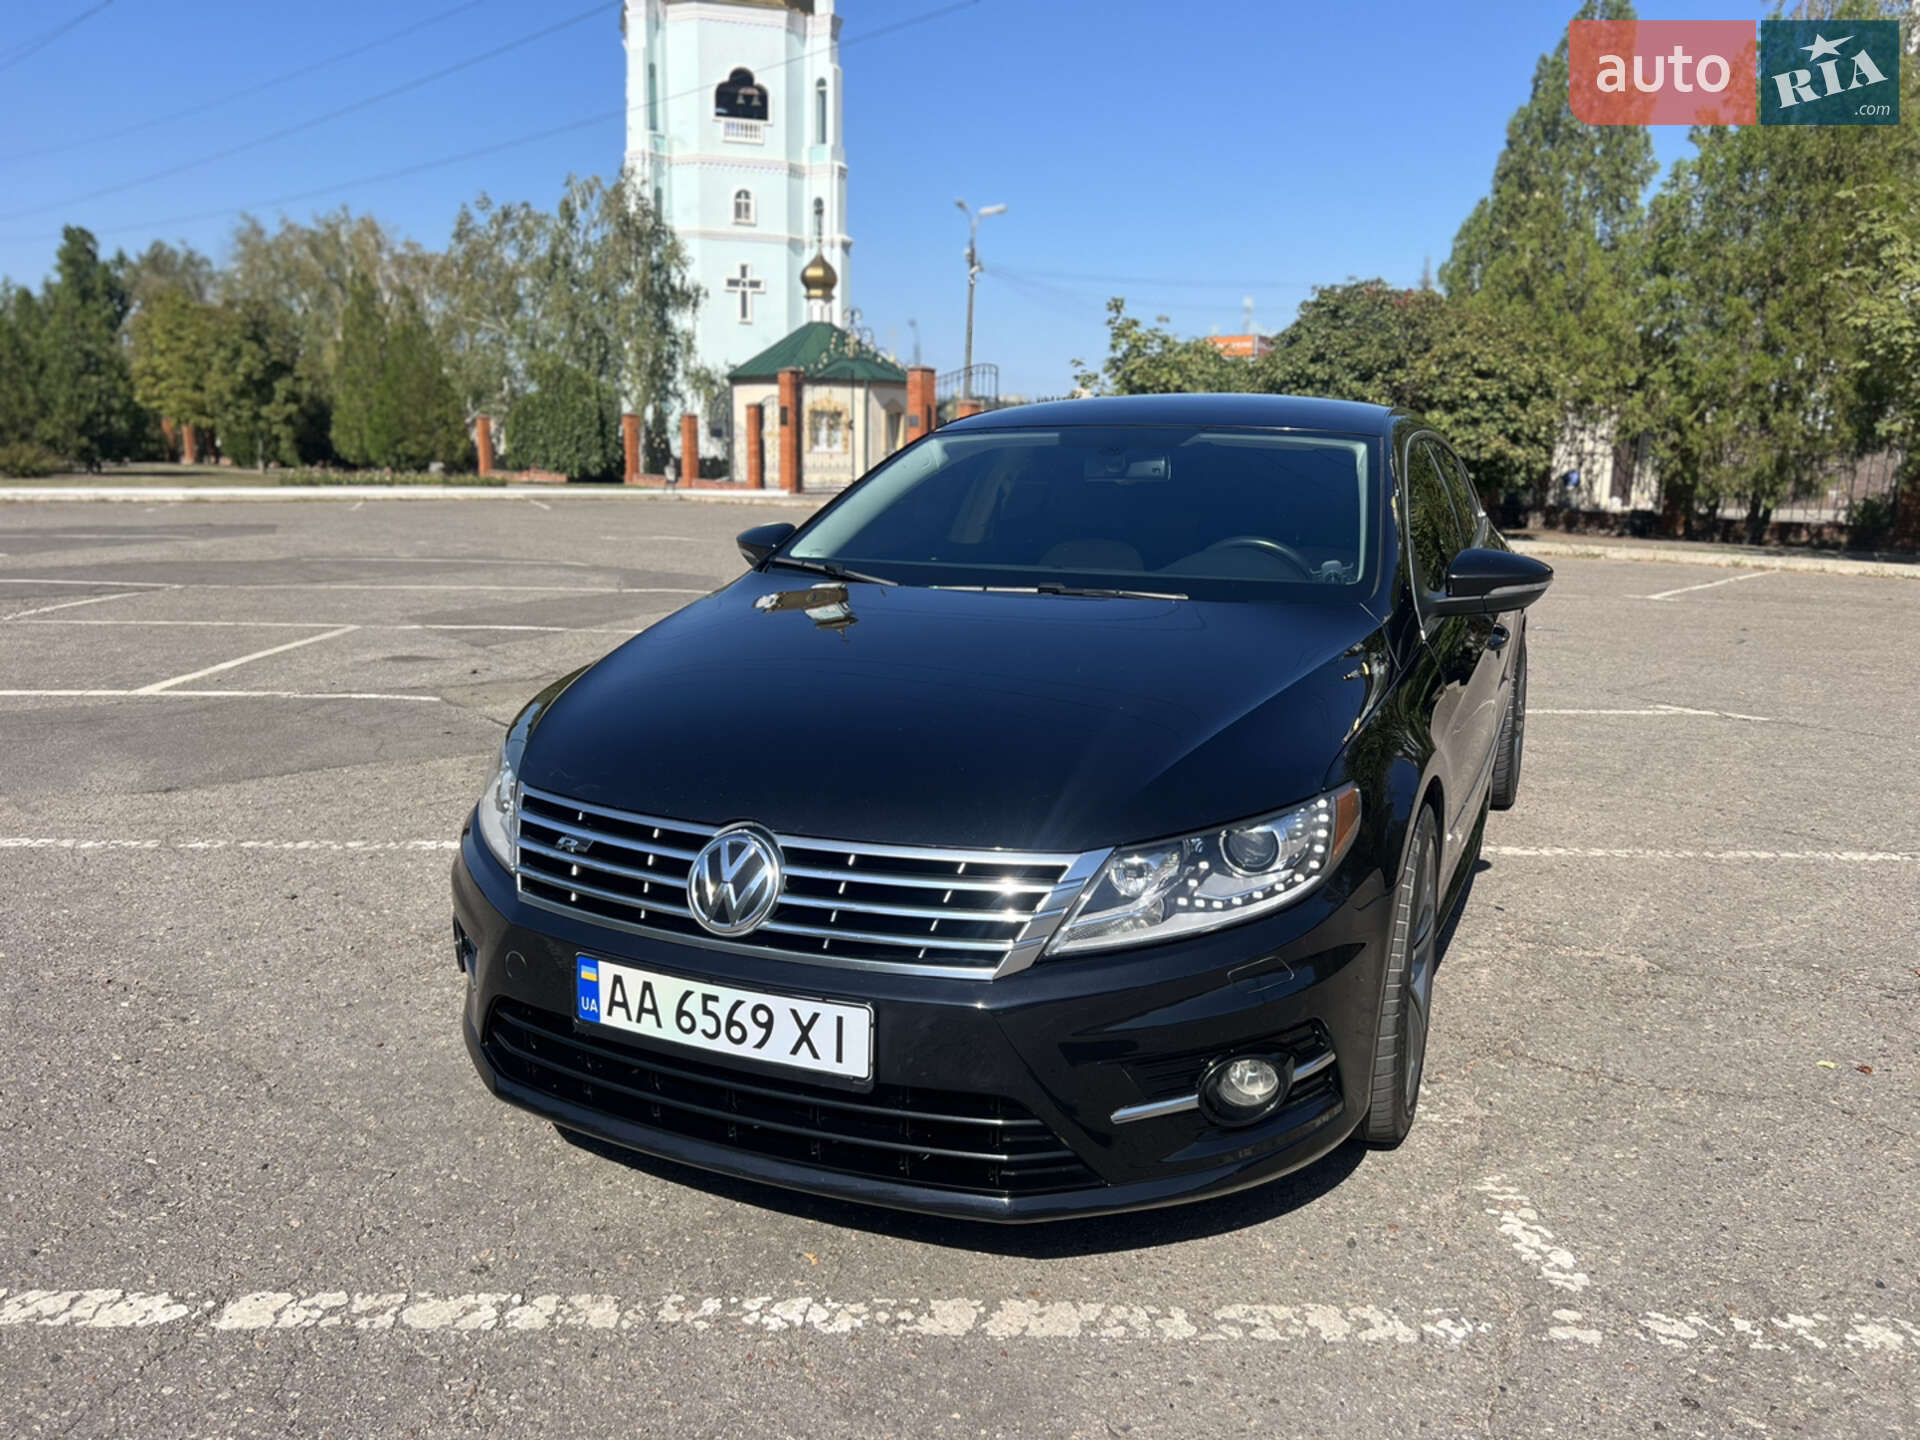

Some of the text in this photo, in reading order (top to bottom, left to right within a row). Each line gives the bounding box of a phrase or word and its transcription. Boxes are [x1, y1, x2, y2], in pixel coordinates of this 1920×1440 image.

[581, 996, 598, 1013] UA
[606, 974, 844, 1064] AA 6569 XI
